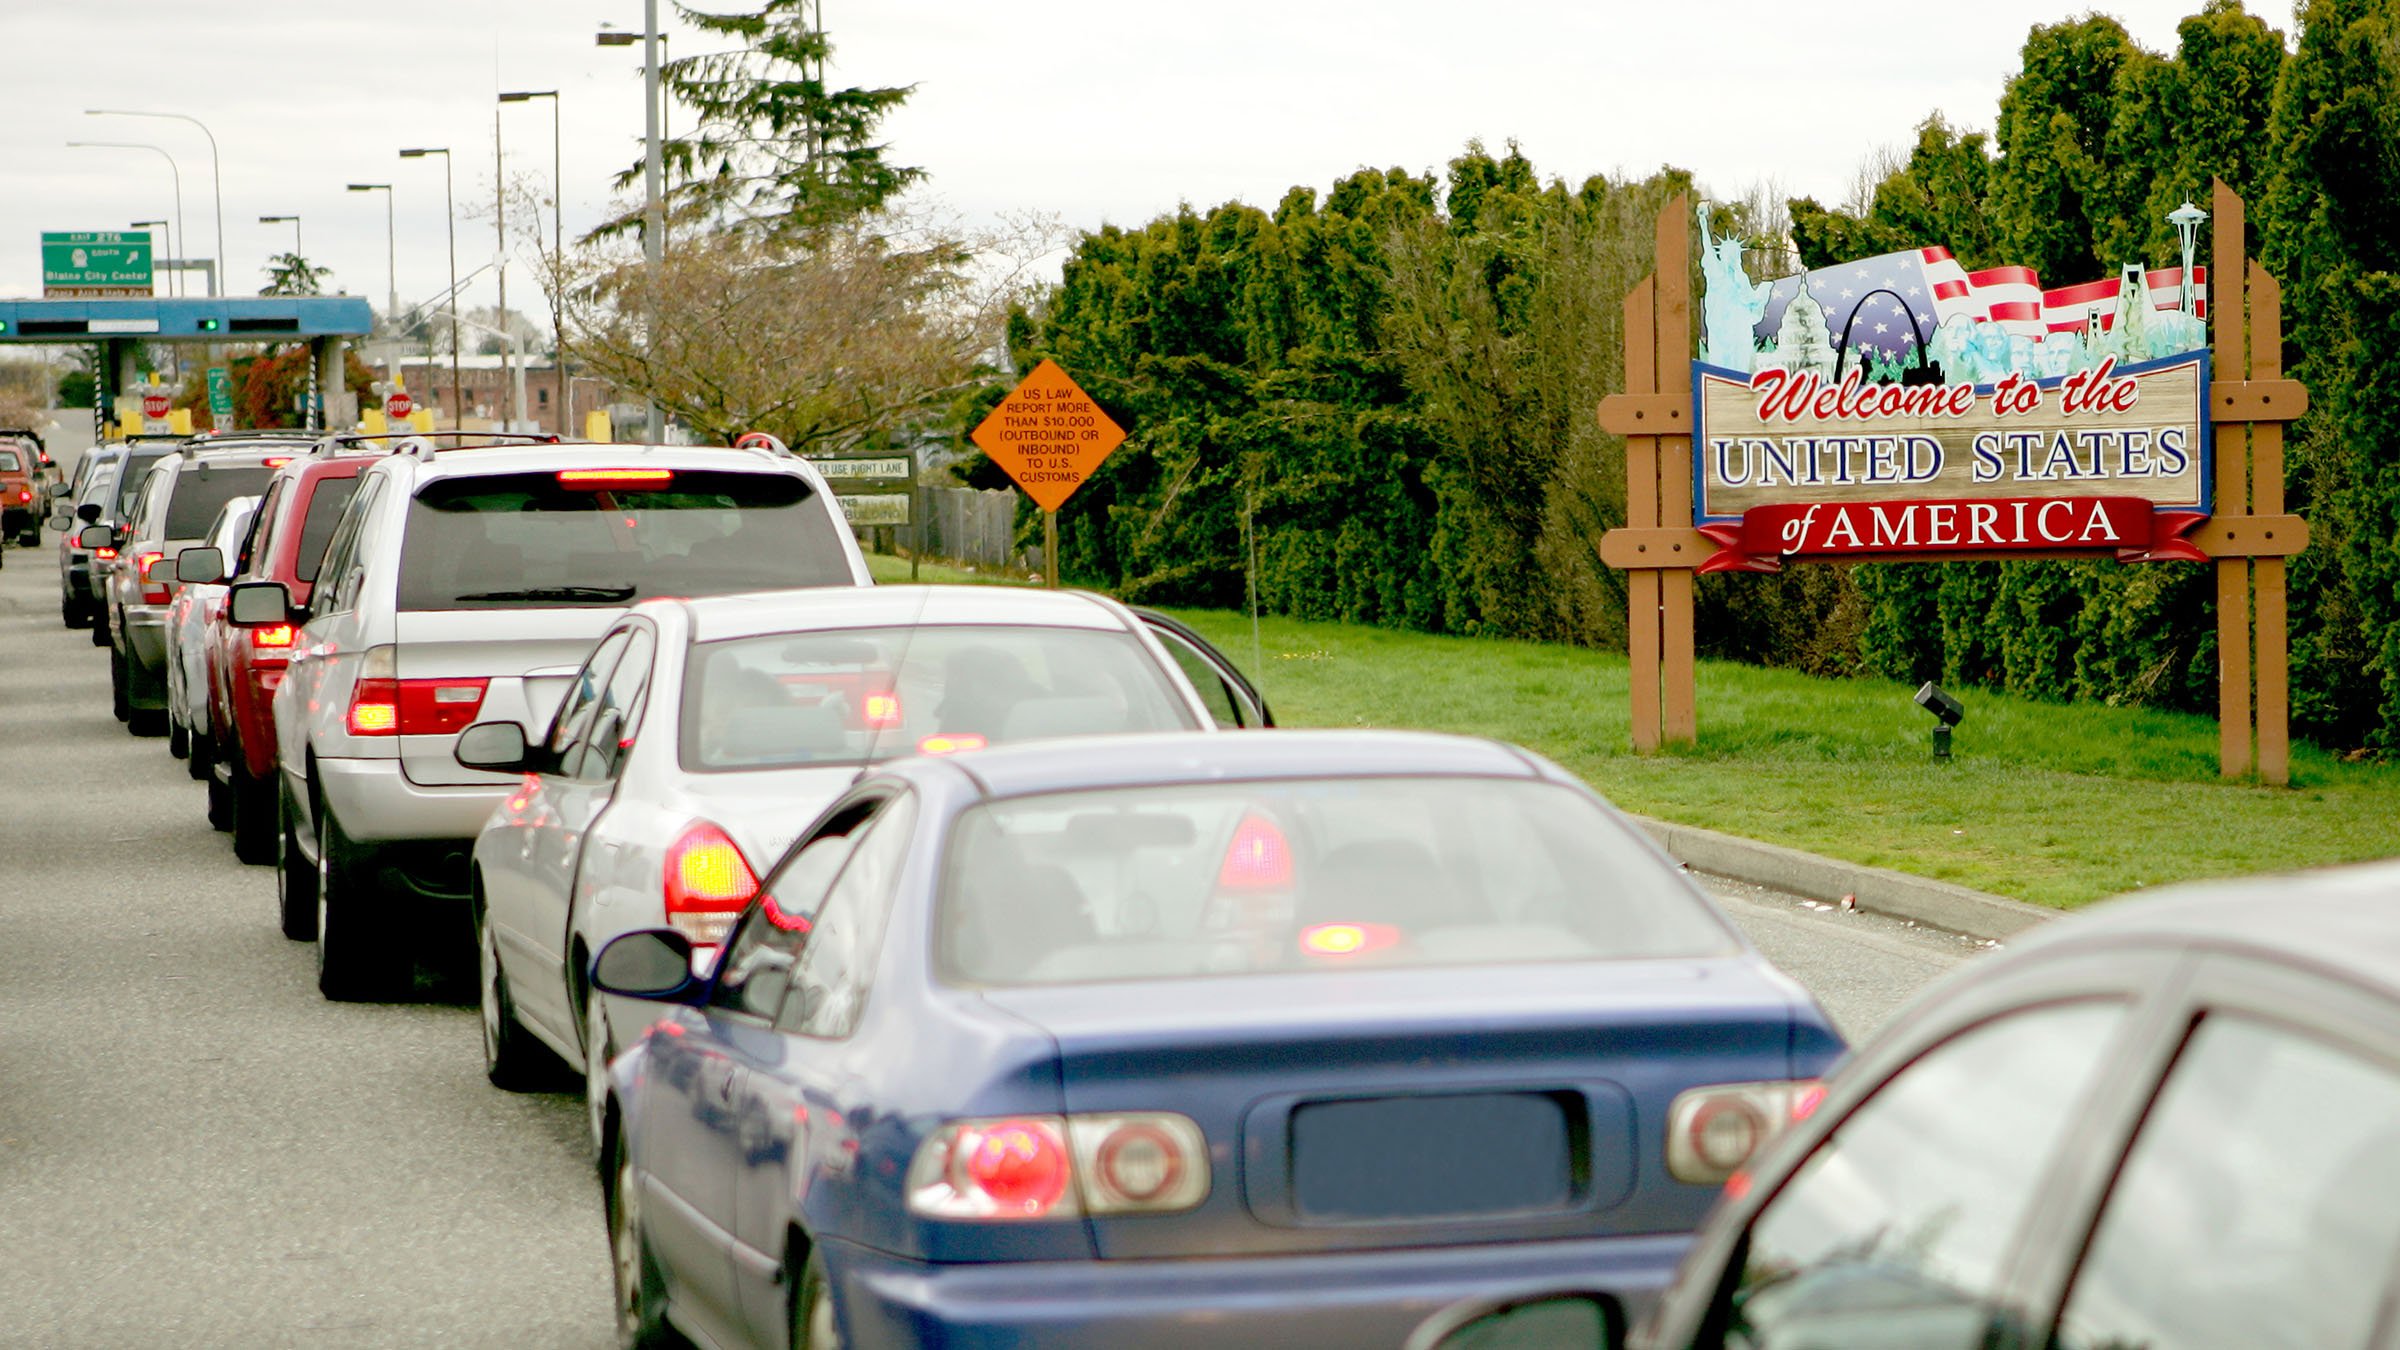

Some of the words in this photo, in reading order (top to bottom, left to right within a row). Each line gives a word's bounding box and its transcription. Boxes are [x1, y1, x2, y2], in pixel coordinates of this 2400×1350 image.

[70, 233, 90, 241] EXIT
[97, 232, 122, 242] 276
[46, 271, 81, 281] Blaine
[85, 271, 107, 282] City
[111, 271, 148, 281] Center
[1751, 366, 1974, 422] Welcome
[1992, 370, 2042, 416] to
[2061, 355, 2139, 416] the
[1023, 389, 1040, 400] US
[1046, 389, 1073, 400] LAW
[144, 401, 170, 412] STOP
[388, 401, 413, 412] STOP
[1006, 402, 1052, 414] REPORT
[1057, 402, 1090, 413] MORE
[1005, 416, 1038, 427] THAN
[1000, 430, 1075, 441] (OUTBOUND
[1080, 430, 1099, 440] OR
[1017, 444, 1080, 455] INBOUND)
[1711, 435, 1944, 487] UNITED
[1973, 428, 2189, 482] STATES
[831, 464, 848, 475] USE
[851, 463, 877, 474] RIGHT
[880, 463, 903, 474] LANE
[1026, 458, 1043, 469] TO
[1049, 458, 1073, 469] U.S.
[1020, 471, 1080, 483] CUSTOMS
[1782, 504, 1821, 555] of
[1822, 500, 2121, 548] AMERICA
